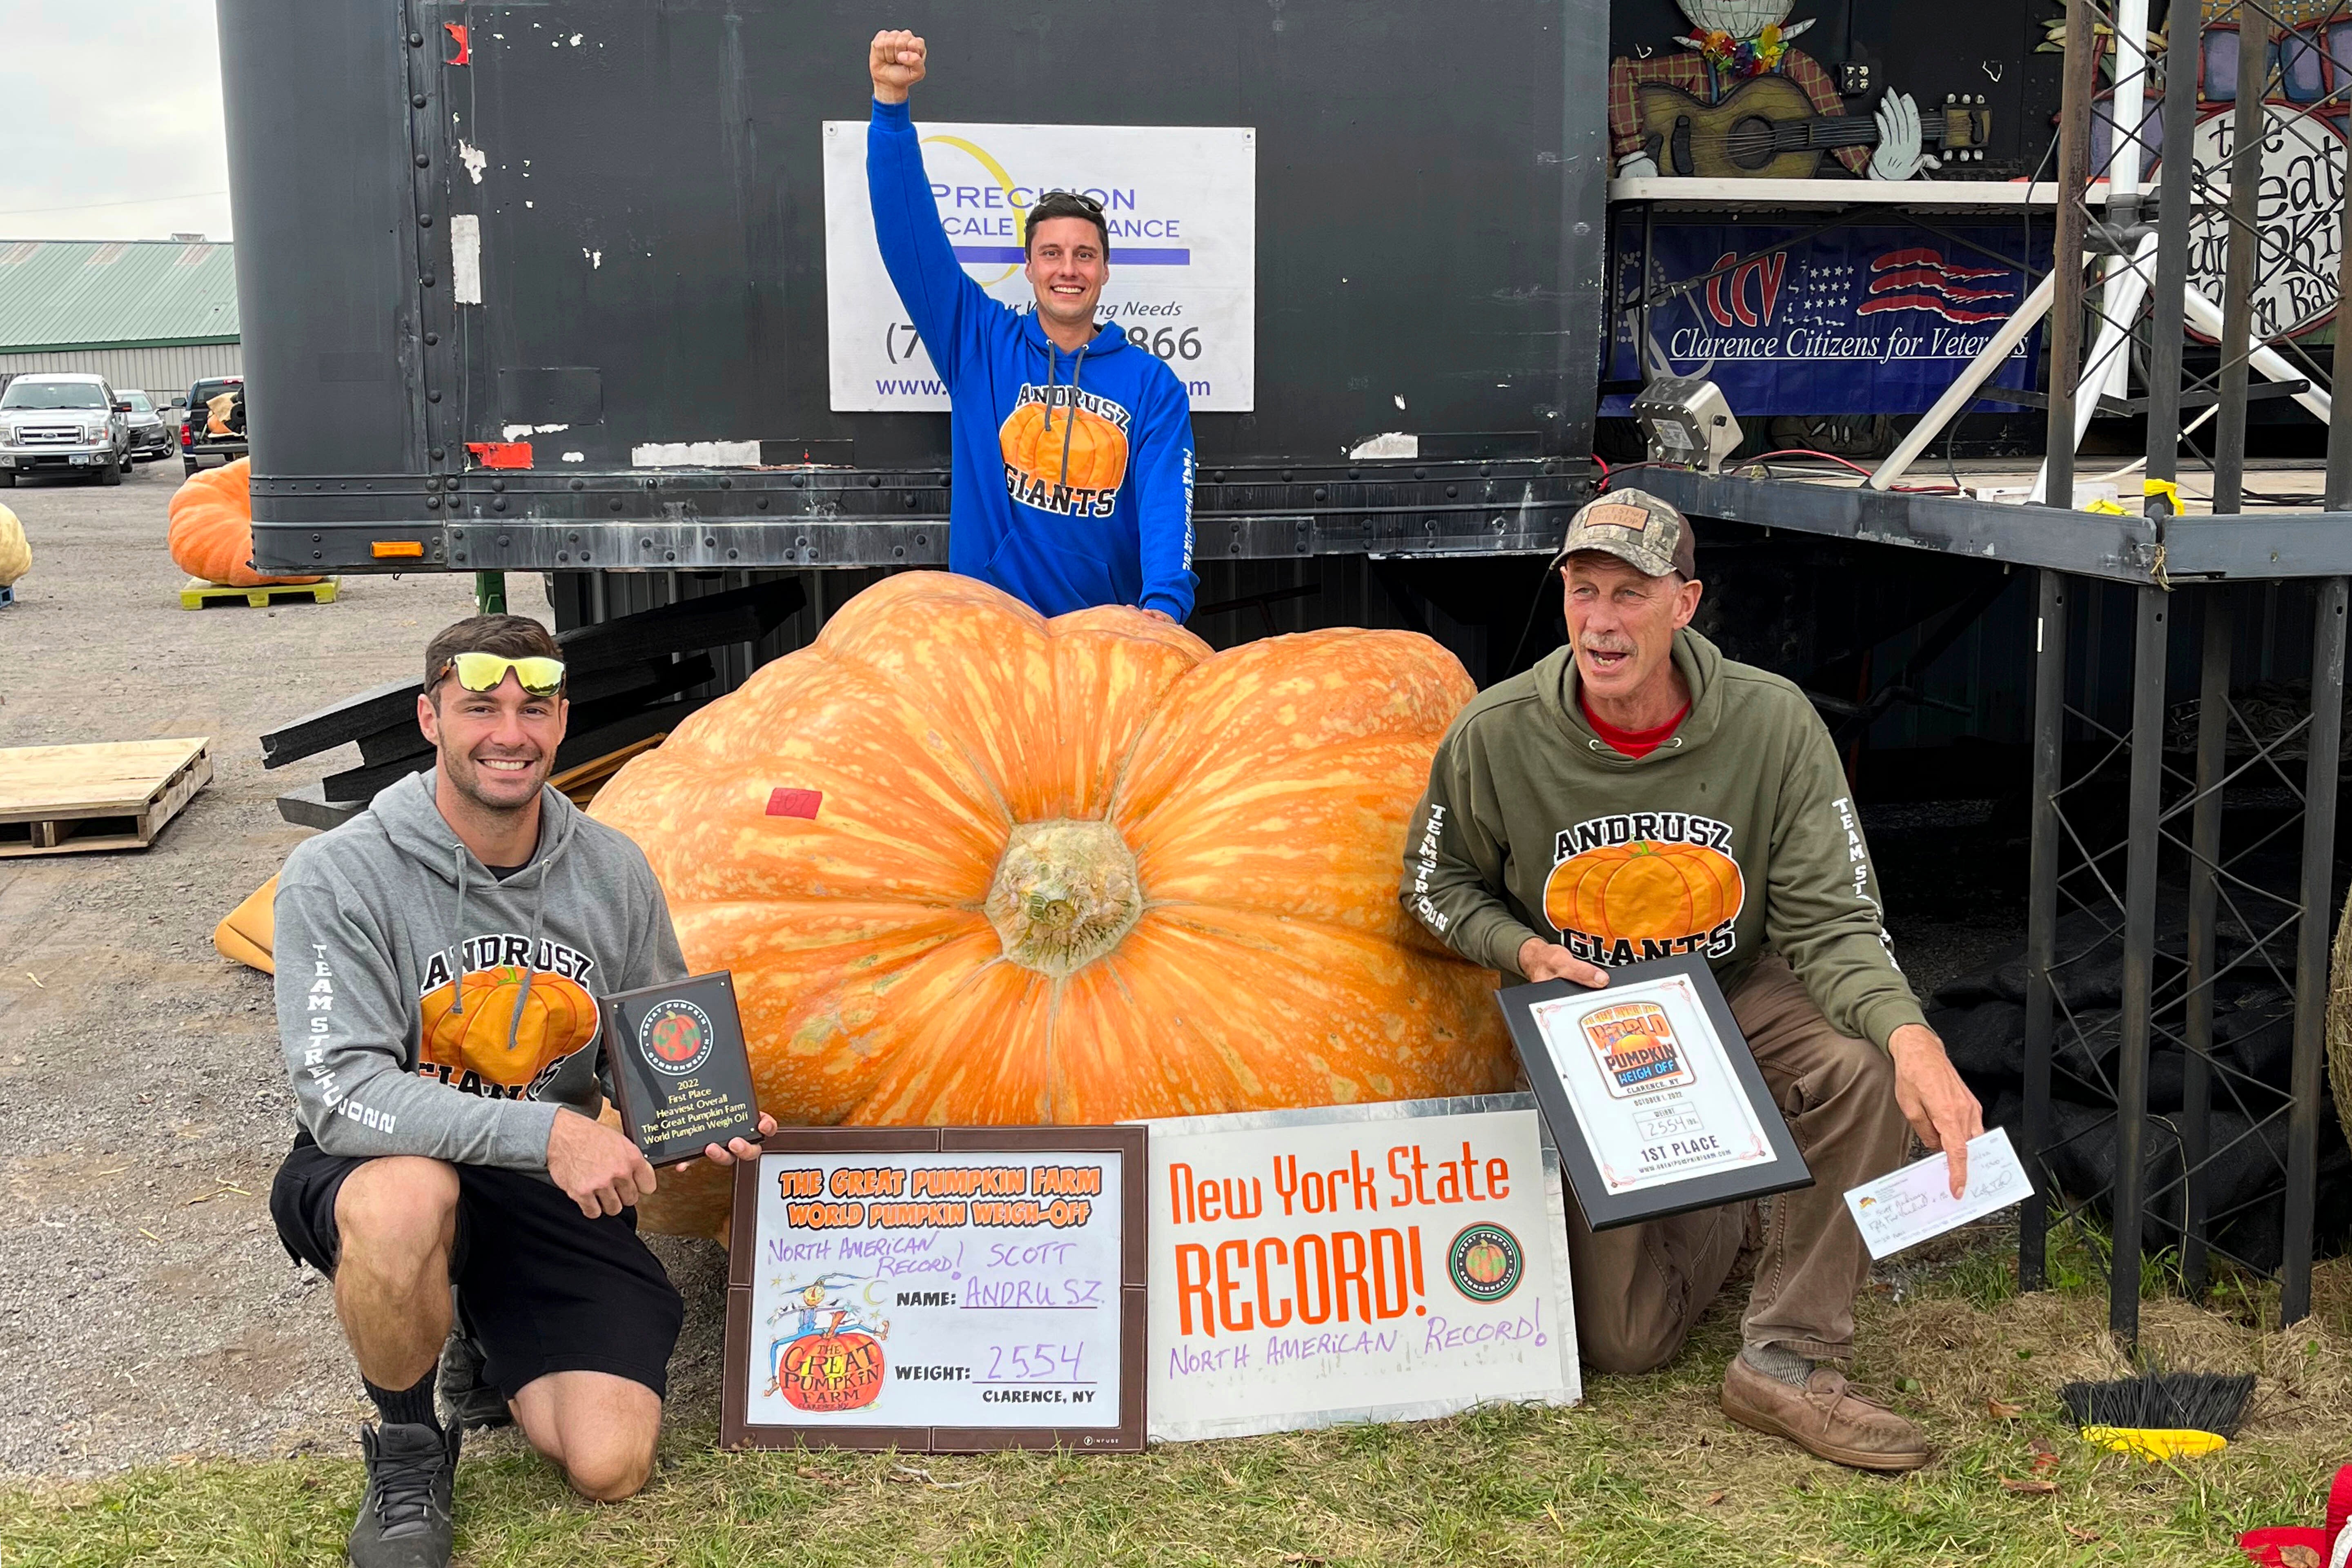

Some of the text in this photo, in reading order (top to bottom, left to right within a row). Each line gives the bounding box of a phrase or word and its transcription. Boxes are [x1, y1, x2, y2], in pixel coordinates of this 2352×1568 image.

[2209, 116, 2284, 158] te
[932, 184, 1135, 210] PRECON
[942, 217, 1180, 238] CALE ANCE
[1706, 252, 1787, 327] CCV
[1123, 301, 1183, 316] Needs
[1671, 327, 2027, 363] Clarence Citizens for Veters
[1017, 384, 1131, 432] ANDRUSZ
[1004, 463, 1116, 517] GIANTS
[1419, 804, 1446, 861] TEAM
[1555, 813, 1733, 860] ANDRUSZ
[1831, 797, 1865, 863] TEAM
[1562, 919, 1735, 967] GIANTS
[307, 944, 334, 1011] TEAM
[423, 935, 595, 991] ANDRUSZ
[643, 1002, 707, 1037] GREAT PUMPKIN
[648, 1038, 710, 1072] COMMONWEALTH
[1603, 1043, 1678, 1071] PUMPKIN
[1618, 1059, 1675, 1085] WEIGH OFF
[668, 1088, 712, 1104] First Place
[677, 1078, 699, 1091] 2022
[1633, 1095, 1661, 1107] OCTOBER
[1667, 1091, 1683, 1100] 2022
[641, 1102, 746, 1134] The Great Pumpkin Farm
[656, 1093, 728, 1119] Heaviest Overall
[643, 1111, 748, 1145] World Pumpkin Weigh Off
[1646, 1115, 1687, 1136] 2554
[1640, 1135, 1720, 1163] 1ST PLACE
[778, 1165, 1102, 1199] THE GREAT PUMPKIN FARM
[1169, 1140, 1510, 1224] New York State
[786, 1197, 1092, 1231] WORLD PUMPKIN WEIGH-OFF
[768, 1238, 832, 1265] NORTH
[875, 1240, 964, 1280] RECORD!
[987, 1241, 1078, 1267] SCOTT
[1480, 1233, 1512, 1256] PUMPKIN
[1174, 1225, 1428, 1339] RECORD!
[897, 1292, 956, 1307] NAME:
[817, 1344, 842, 1355] THE
[1169, 1343, 1250, 1380] NORTH
[1423, 1297, 1548, 1355] RECORD!
[785, 1342, 876, 1378] GREAT
[895, 1365, 971, 1381] WEIGHT:
[987, 1341, 1084, 1381] 2554
[800, 1388, 861, 1404] FARM
[982, 1390, 1096, 1405] CLARENCE, NY
